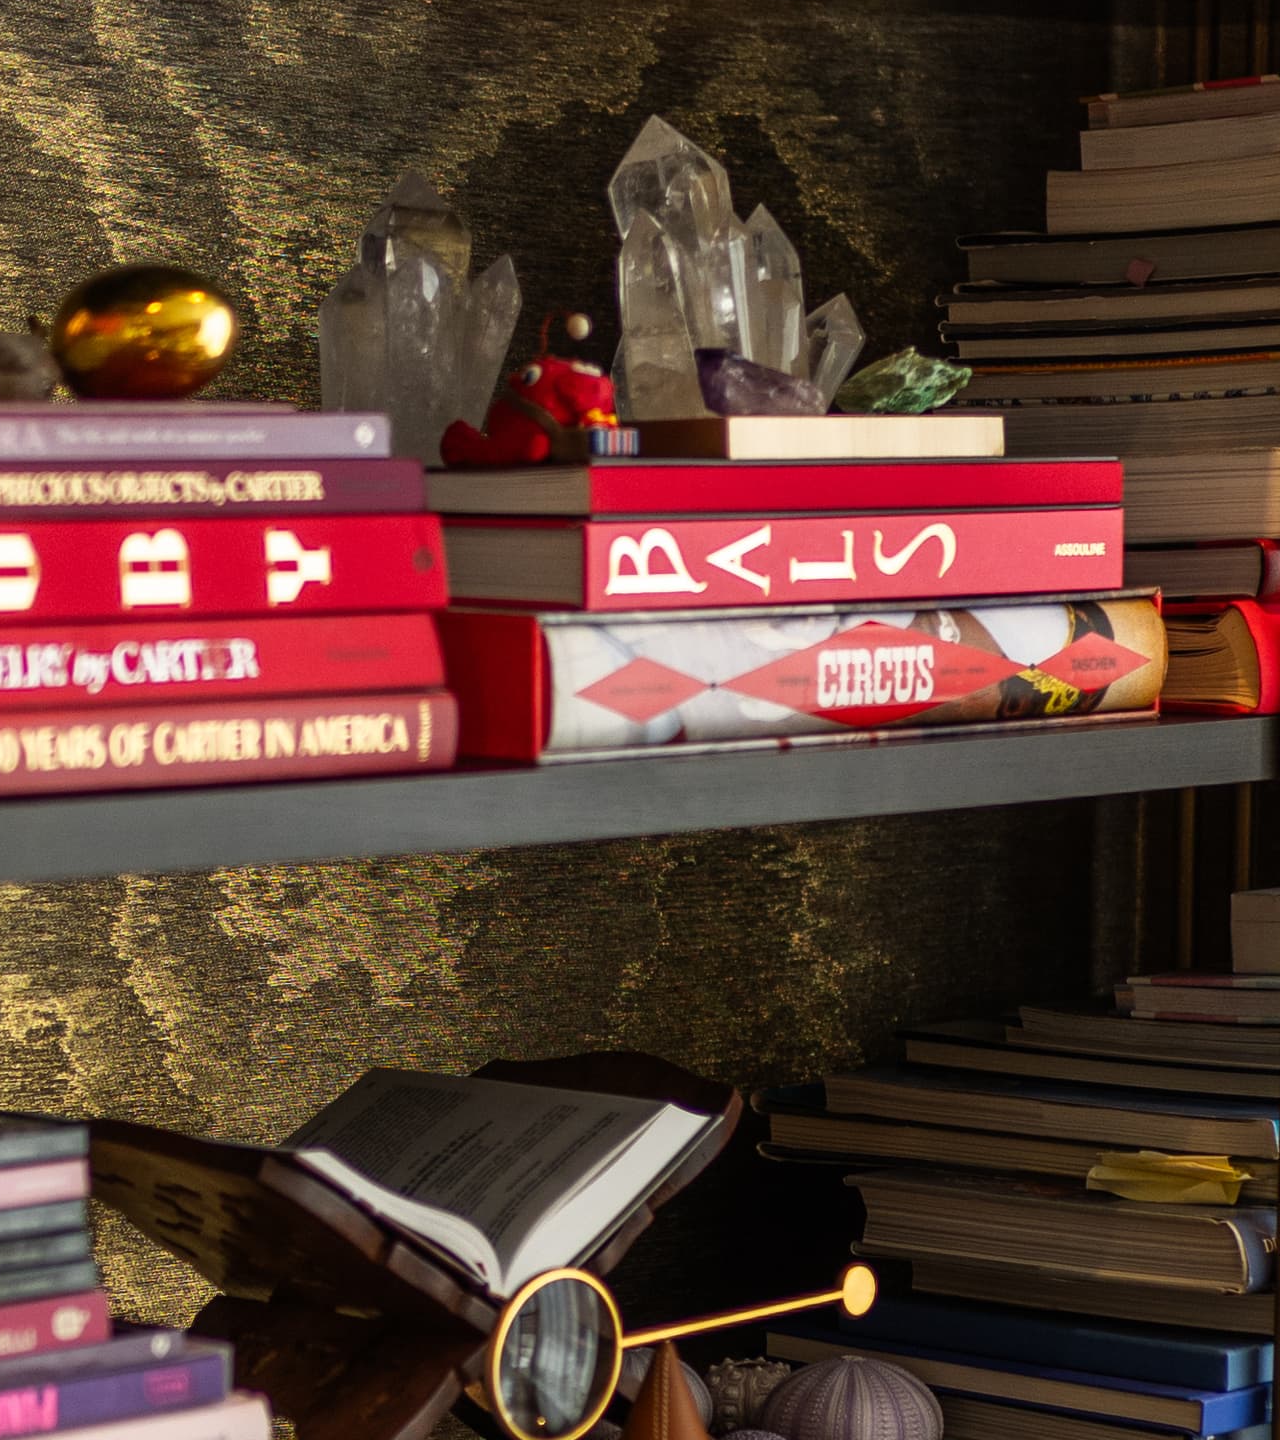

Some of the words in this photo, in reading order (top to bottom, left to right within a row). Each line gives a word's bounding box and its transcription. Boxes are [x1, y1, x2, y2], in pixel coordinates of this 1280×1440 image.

[105, 469, 212, 504] OBJECTS
[224, 469, 325, 502] CARTIER
[605, 523, 958, 597] BALS
[1053, 541, 1107, 558] ASSOULINE
[72, 648, 112, 695] by
[110, 637, 262, 685] CARTR
[818, 644, 935, 709] CIRCUS
[1070, 655, 1117, 672] TASCHEN
[20, 723, 107, 772] YEARS
[108, 721, 151, 767] OF
[152, 717, 263, 766] CARTIER
[263, 716, 297, 759] IN
[298, 712, 411, 757] AMERICA
